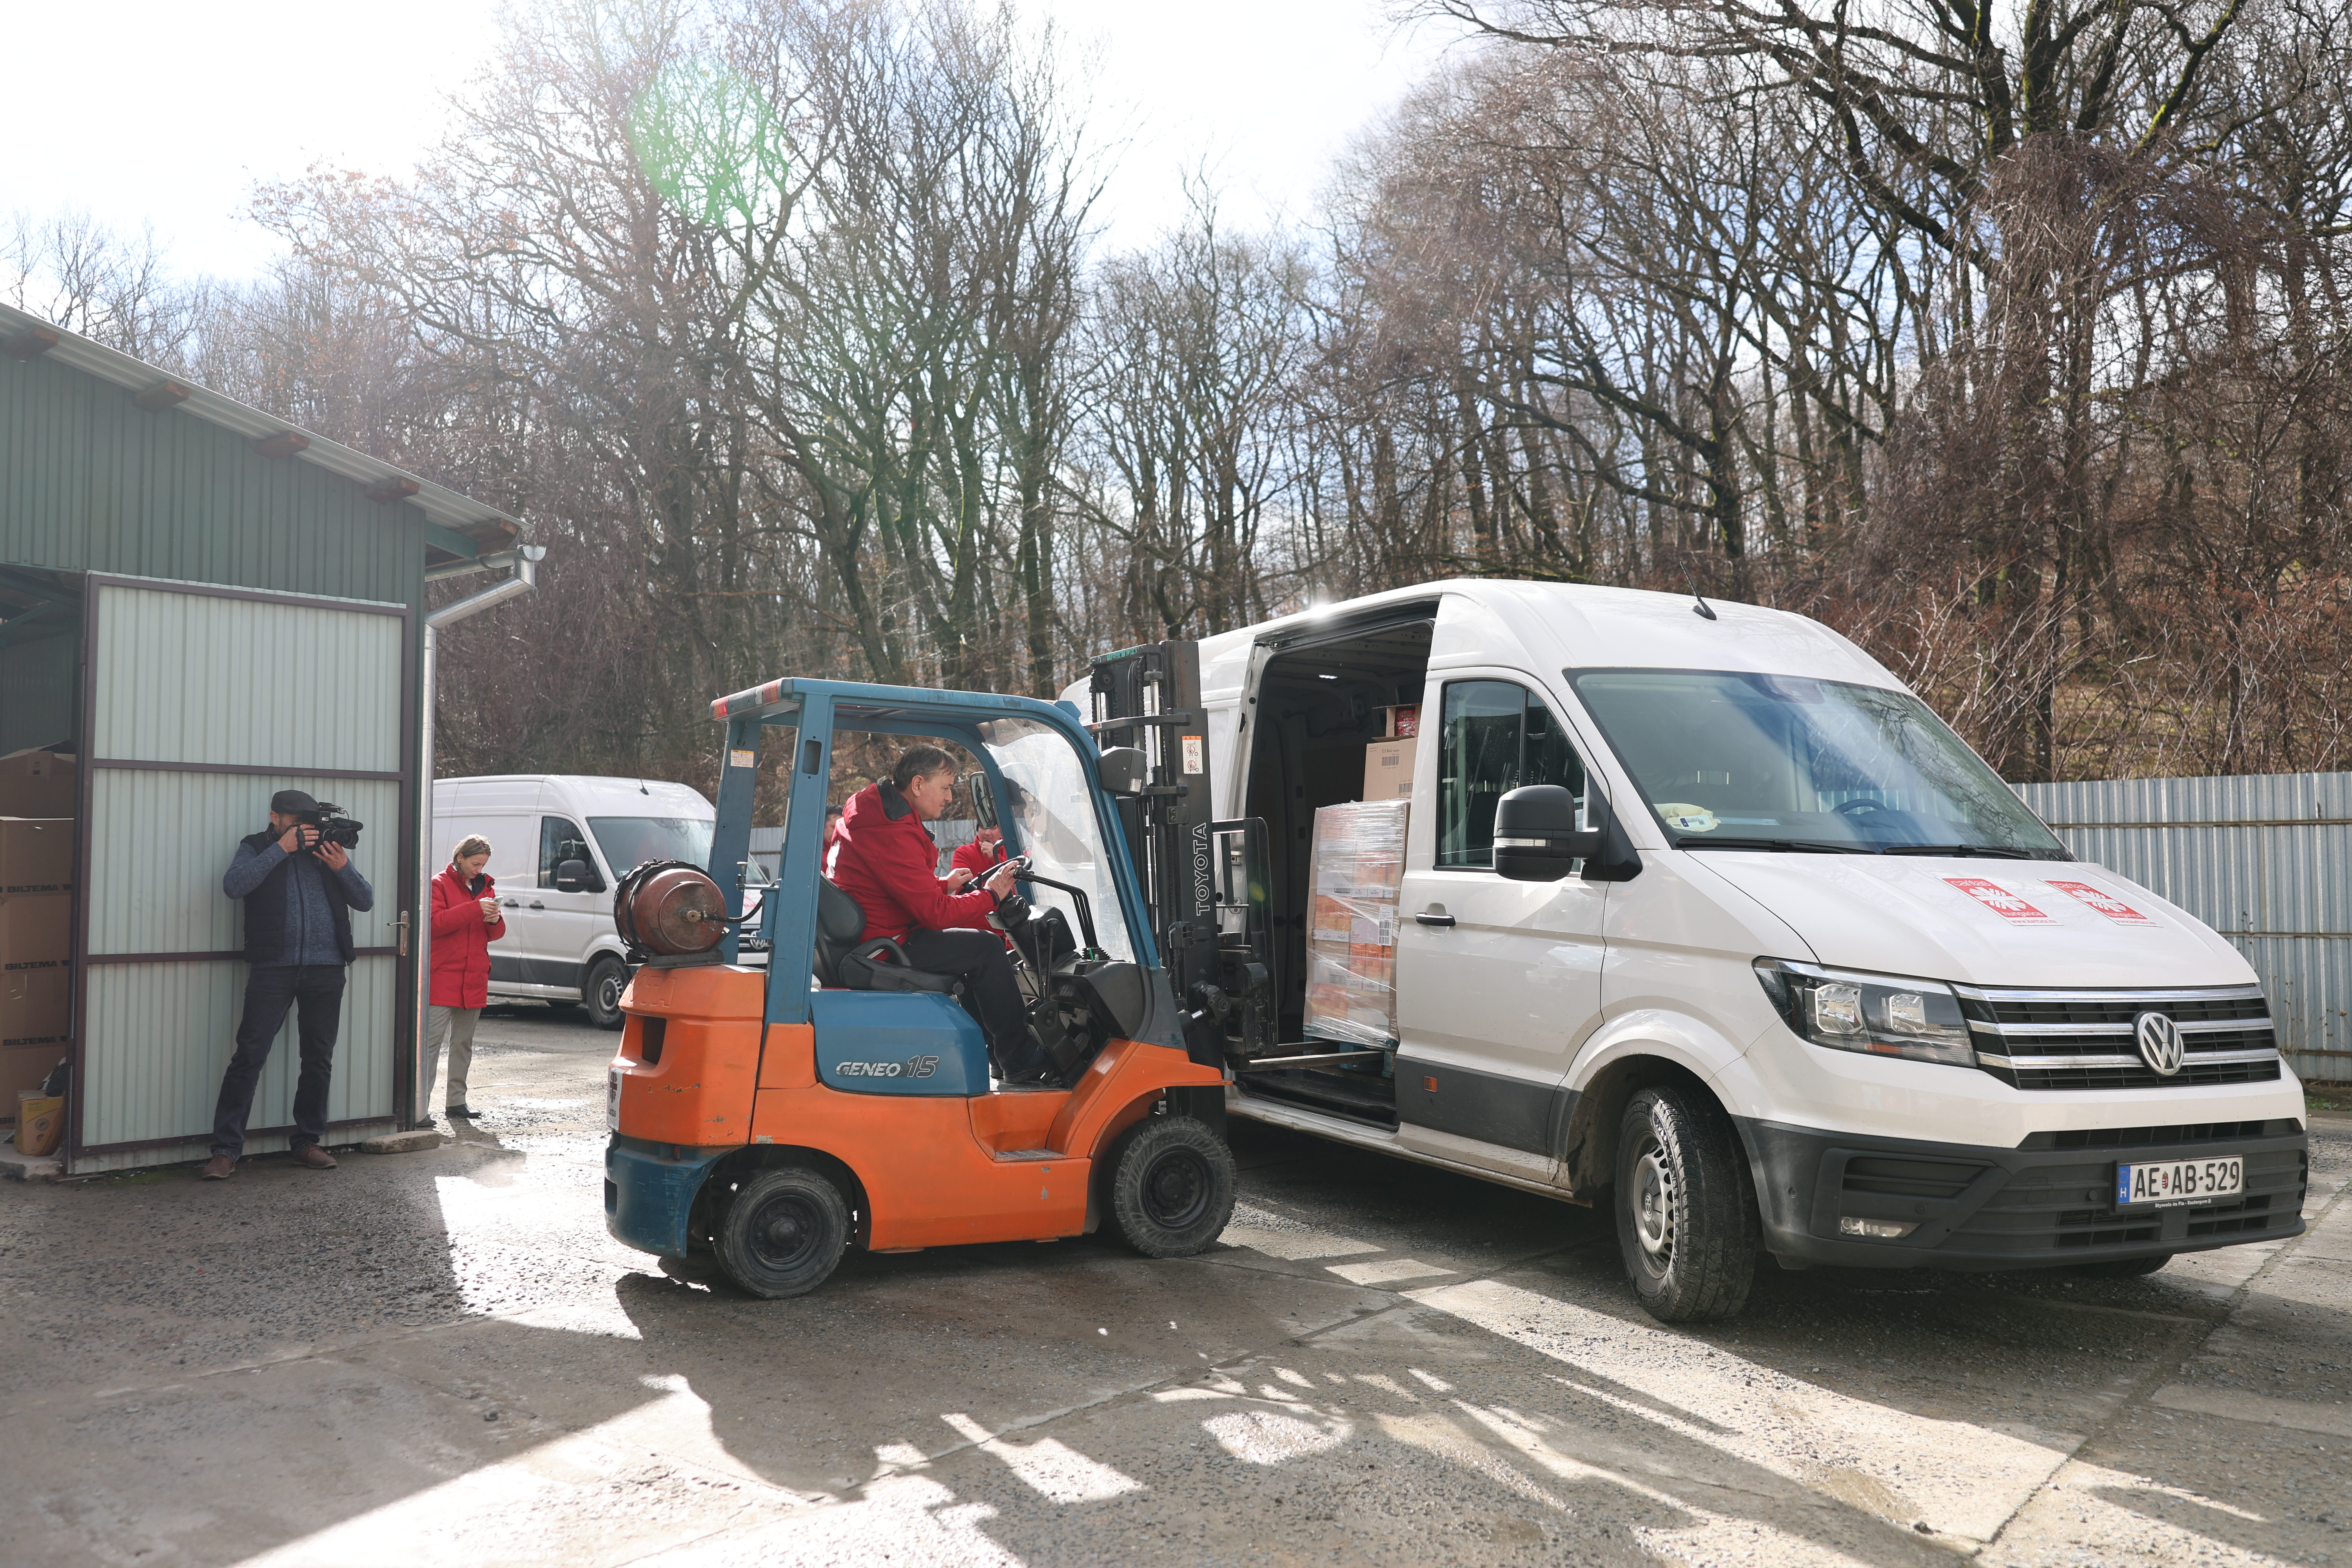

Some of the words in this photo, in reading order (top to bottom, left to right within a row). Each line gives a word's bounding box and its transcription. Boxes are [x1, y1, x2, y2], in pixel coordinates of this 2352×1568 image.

[1193, 822, 1210, 916] TOYOTA
[7, 884, 59, 893] BILTEMA
[5, 960, 58, 970] BILTEMA
[3, 1036, 56, 1046] BILTEMA
[835, 1061, 901, 1077] GENEO
[907, 1054, 939, 1078] 15
[2134, 1167, 2160, 1198] AE
[2120, 1187, 2127, 1198] H
